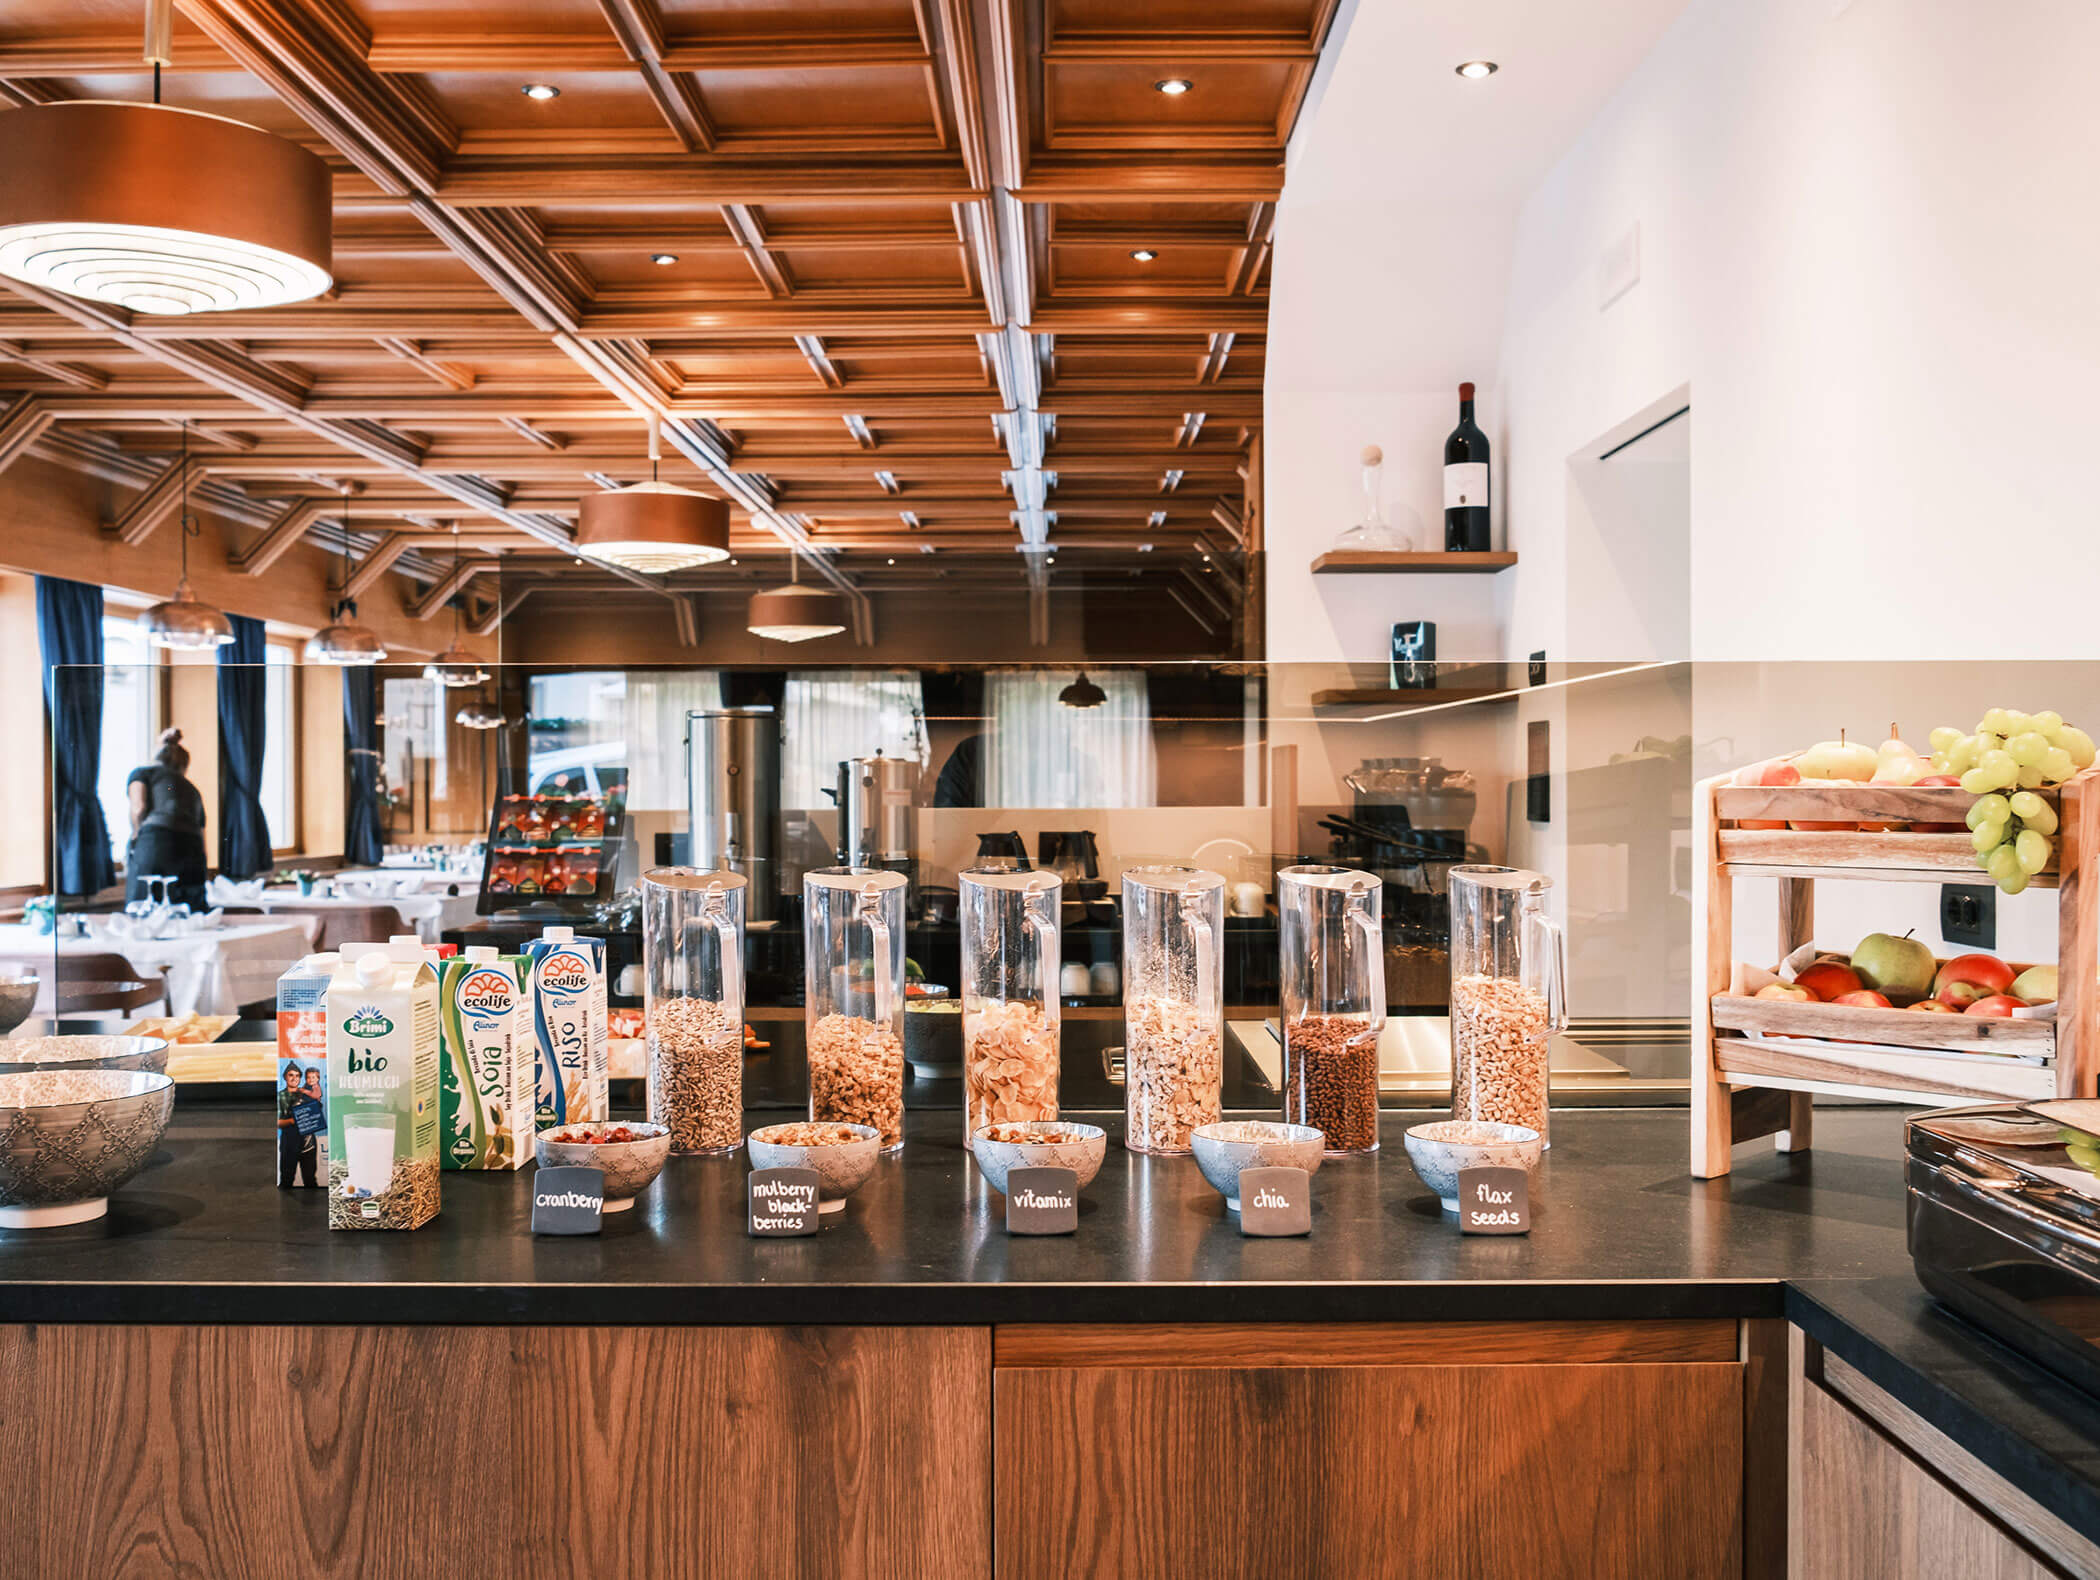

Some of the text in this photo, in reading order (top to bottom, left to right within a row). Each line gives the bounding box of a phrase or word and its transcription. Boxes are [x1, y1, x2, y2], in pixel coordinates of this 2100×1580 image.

[544, 975, 587, 987] ecolife
[464, 995, 511, 1008] ecolife
[349, 1020, 387, 1033] Brimi
[348, 1047, 388, 1074] bio
[480, 1046, 504, 1097] Soia
[339, 1075, 399, 1089] HEUMILCH
[753, 1180, 815, 1202] mulberry
[1014, 1188, 1072, 1208] vitamix
[1253, 1188, 1290, 1208] chia
[1476, 1183, 1513, 1204] flax
[536, 1190, 604, 1215] cranberry
[767, 1198, 812, 1213] black-
[753, 1213, 804, 1230] berries
[1471, 1209, 1521, 1225] seeds
